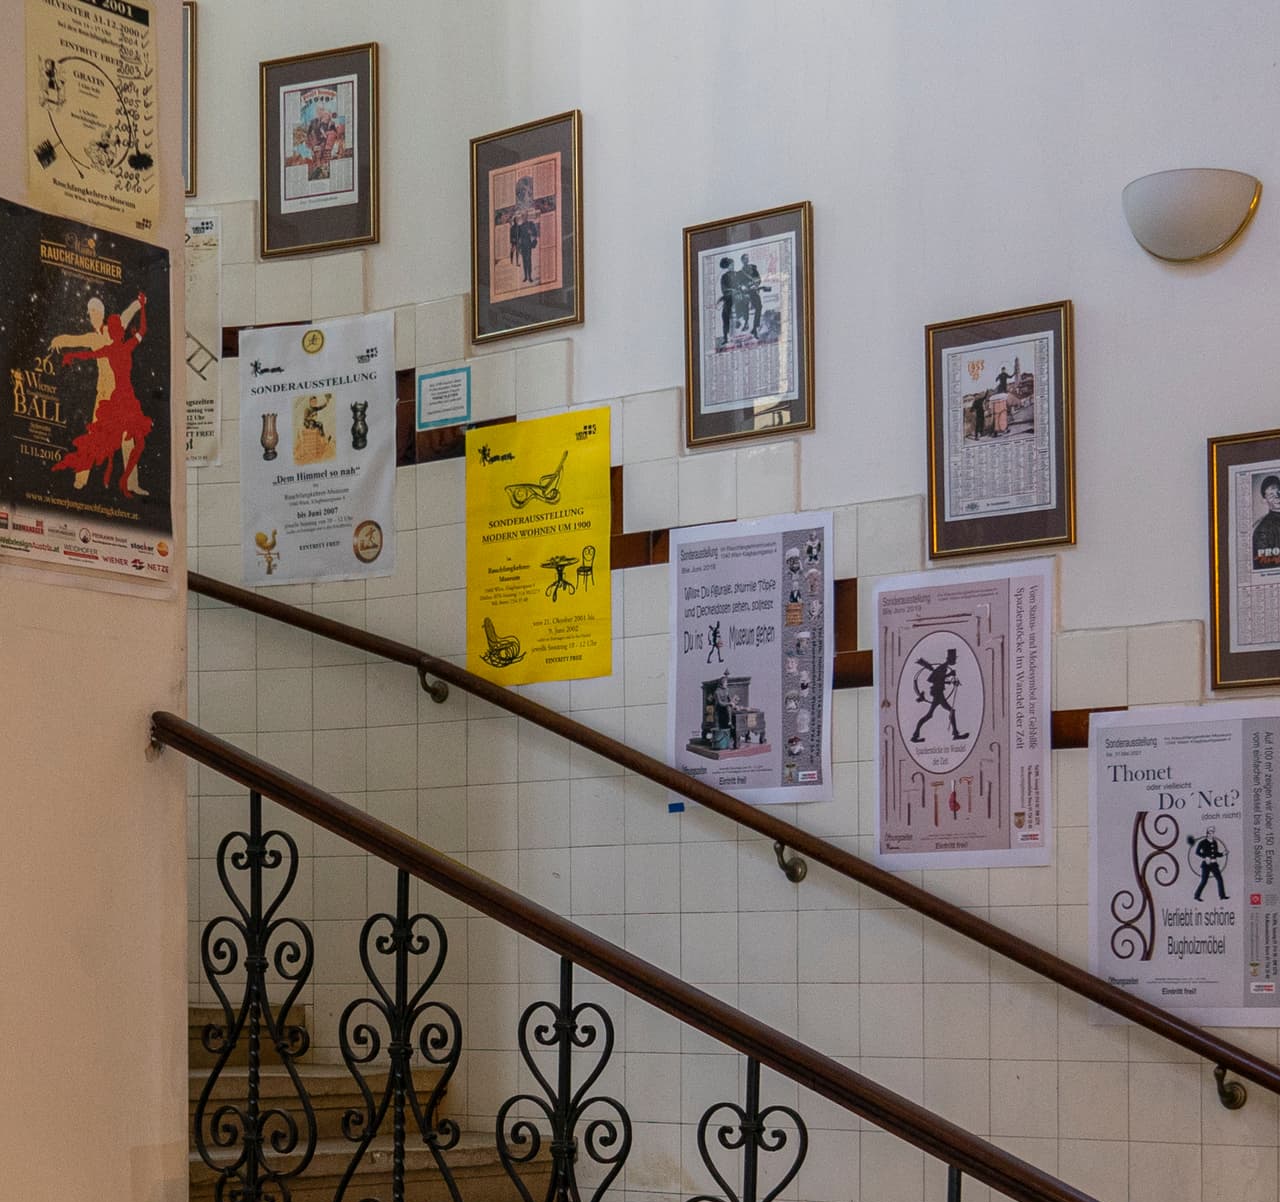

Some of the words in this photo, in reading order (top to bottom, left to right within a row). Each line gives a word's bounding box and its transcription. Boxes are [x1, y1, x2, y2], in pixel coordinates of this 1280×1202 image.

[40, 244, 122, 279] RAUCHFANGKEHRER
[34, 354, 56, 376] 26.
[24, 370, 58, 394] Wiener
[250, 371, 378, 396] SONDERAUSSTELLUNG
[13, 392, 67, 425] BALL
[20, 444, 62, 461] 11.11.2016
[296, 469, 328, 482] Himmel
[297, 511, 307, 519] bis
[488, 507, 585, 529] SONDERAUSSTELLUNG
[482, 530, 518, 544] MODERN
[519, 526, 557, 538] WOHNEN
[558, 523, 571, 532] UM
[573, 521, 591, 530] 1900
[102, 554, 129, 567] WIENER
[757, 579, 776, 593] Töpfe
[684, 631, 695, 654] Du
[696, 631, 704, 650] ins
[729, 625, 755, 649] Museum
[756, 625, 776, 647] gehen
[1015, 671, 1024, 709] Wandel
[1015, 713, 1024, 728] der
[1105, 736, 1158, 749] Sonderausstellung
[1252, 732, 1261, 749] vom
[1264, 731, 1274, 746] Auf
[1264, 747, 1273, 761] 100
[1107, 764, 1173, 783] Thonet
[1146, 783, 1162, 791] oder
[1162, 781, 1192, 791] vielleicht
[1159, 792, 1186, 810] Do
[1201, 812, 1221, 821] (doch
[1253, 814, 1262, 826] bis
[1253, 827, 1261, 844] zum
[1162, 908, 1193, 927] Verliebt
[1194, 907, 1203, 925] in
[1204, 906, 1236, 926] schöne
[1167, 936, 1226, 960] Bugholzmöbel
